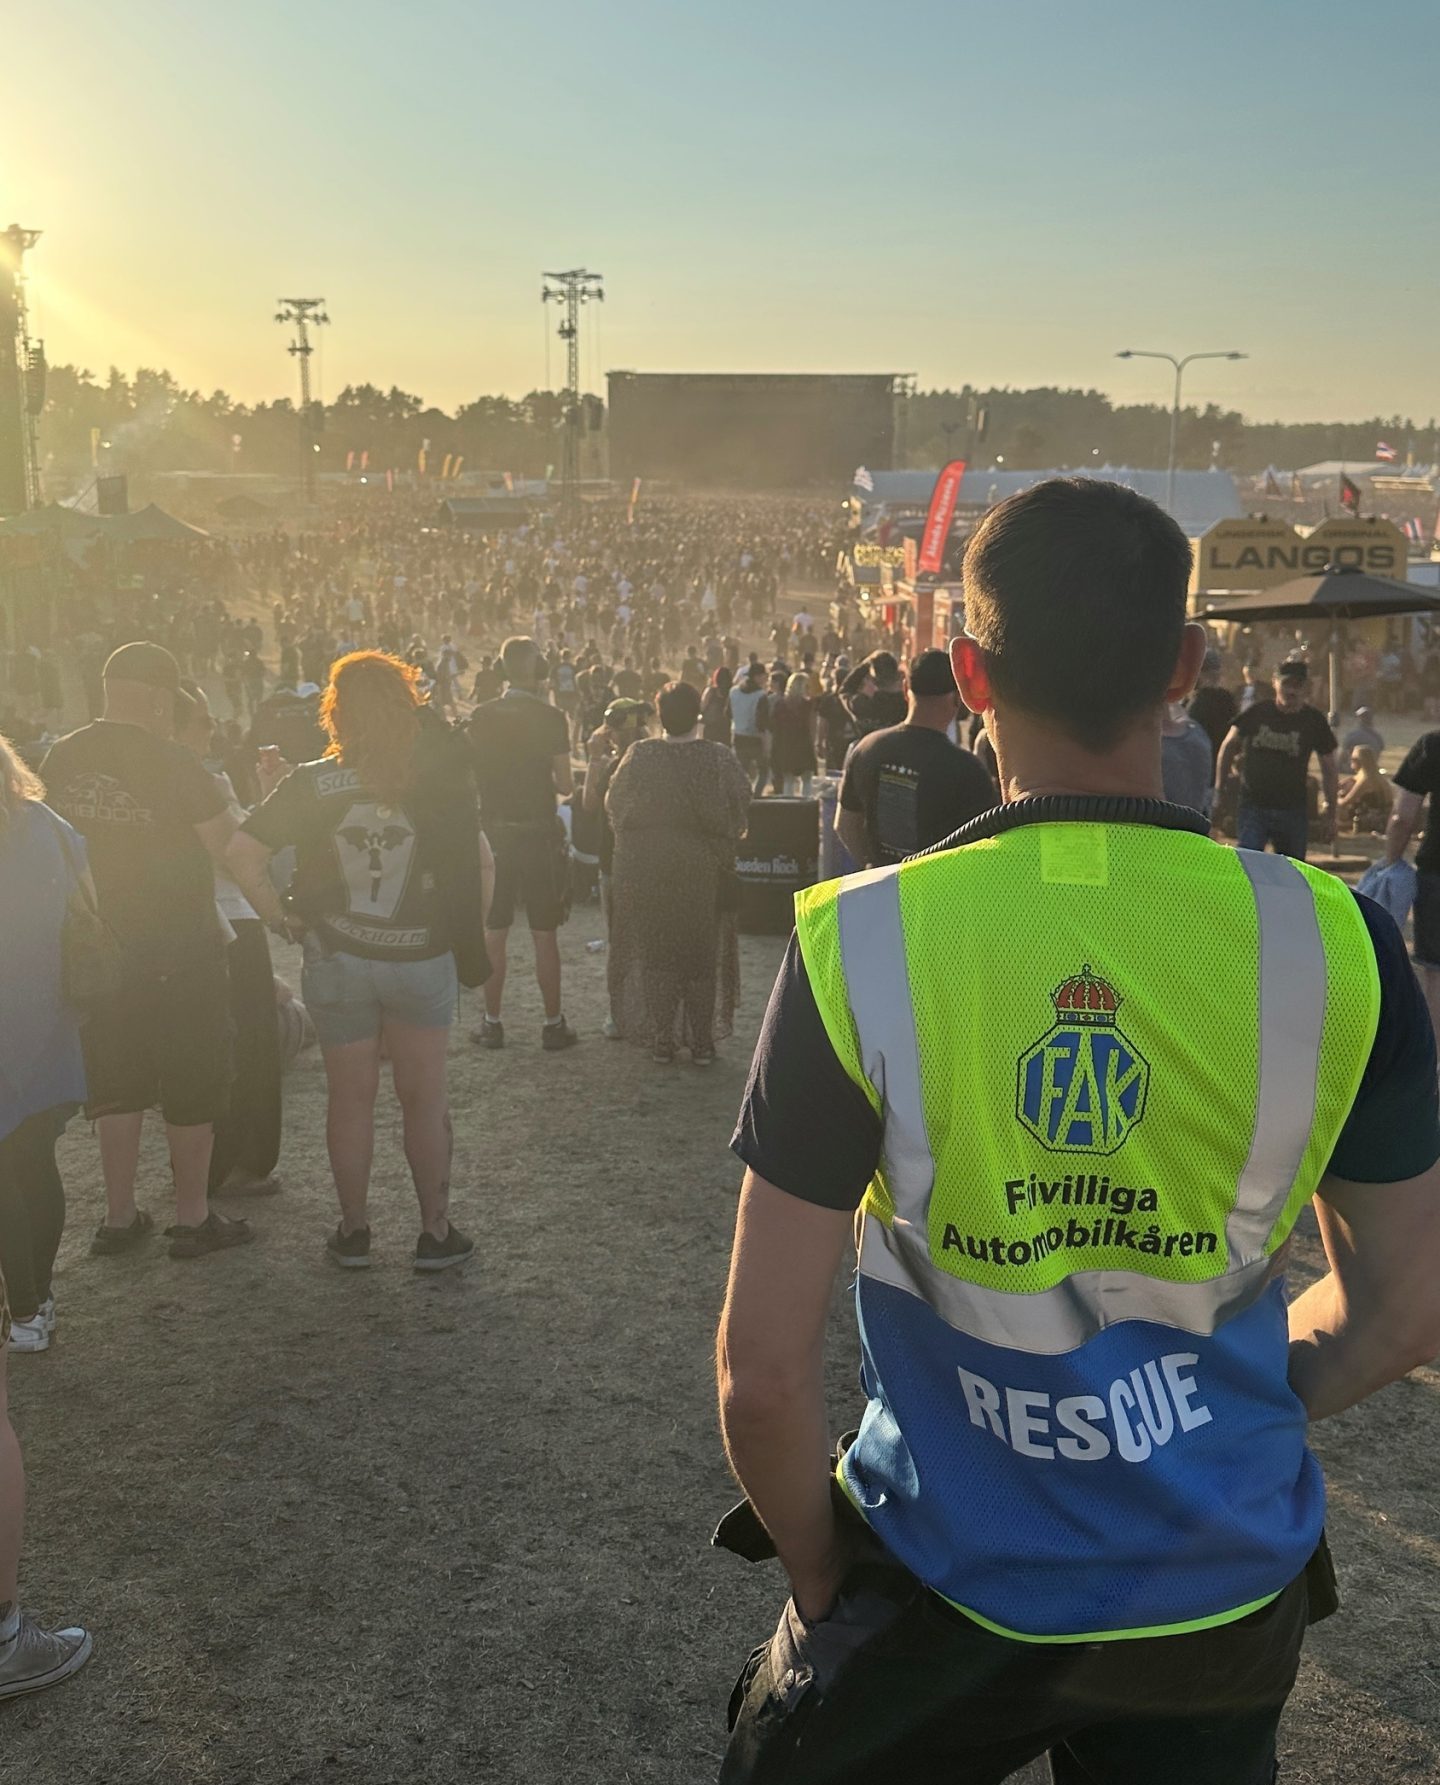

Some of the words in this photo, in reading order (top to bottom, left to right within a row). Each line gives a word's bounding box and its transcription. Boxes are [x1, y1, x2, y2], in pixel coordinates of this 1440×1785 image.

[1209, 546, 1395, 570] LANGOS
[942, 1219, 1217, 1266] Automobilkåren
[957, 1352, 1213, 1463] RESCUE
